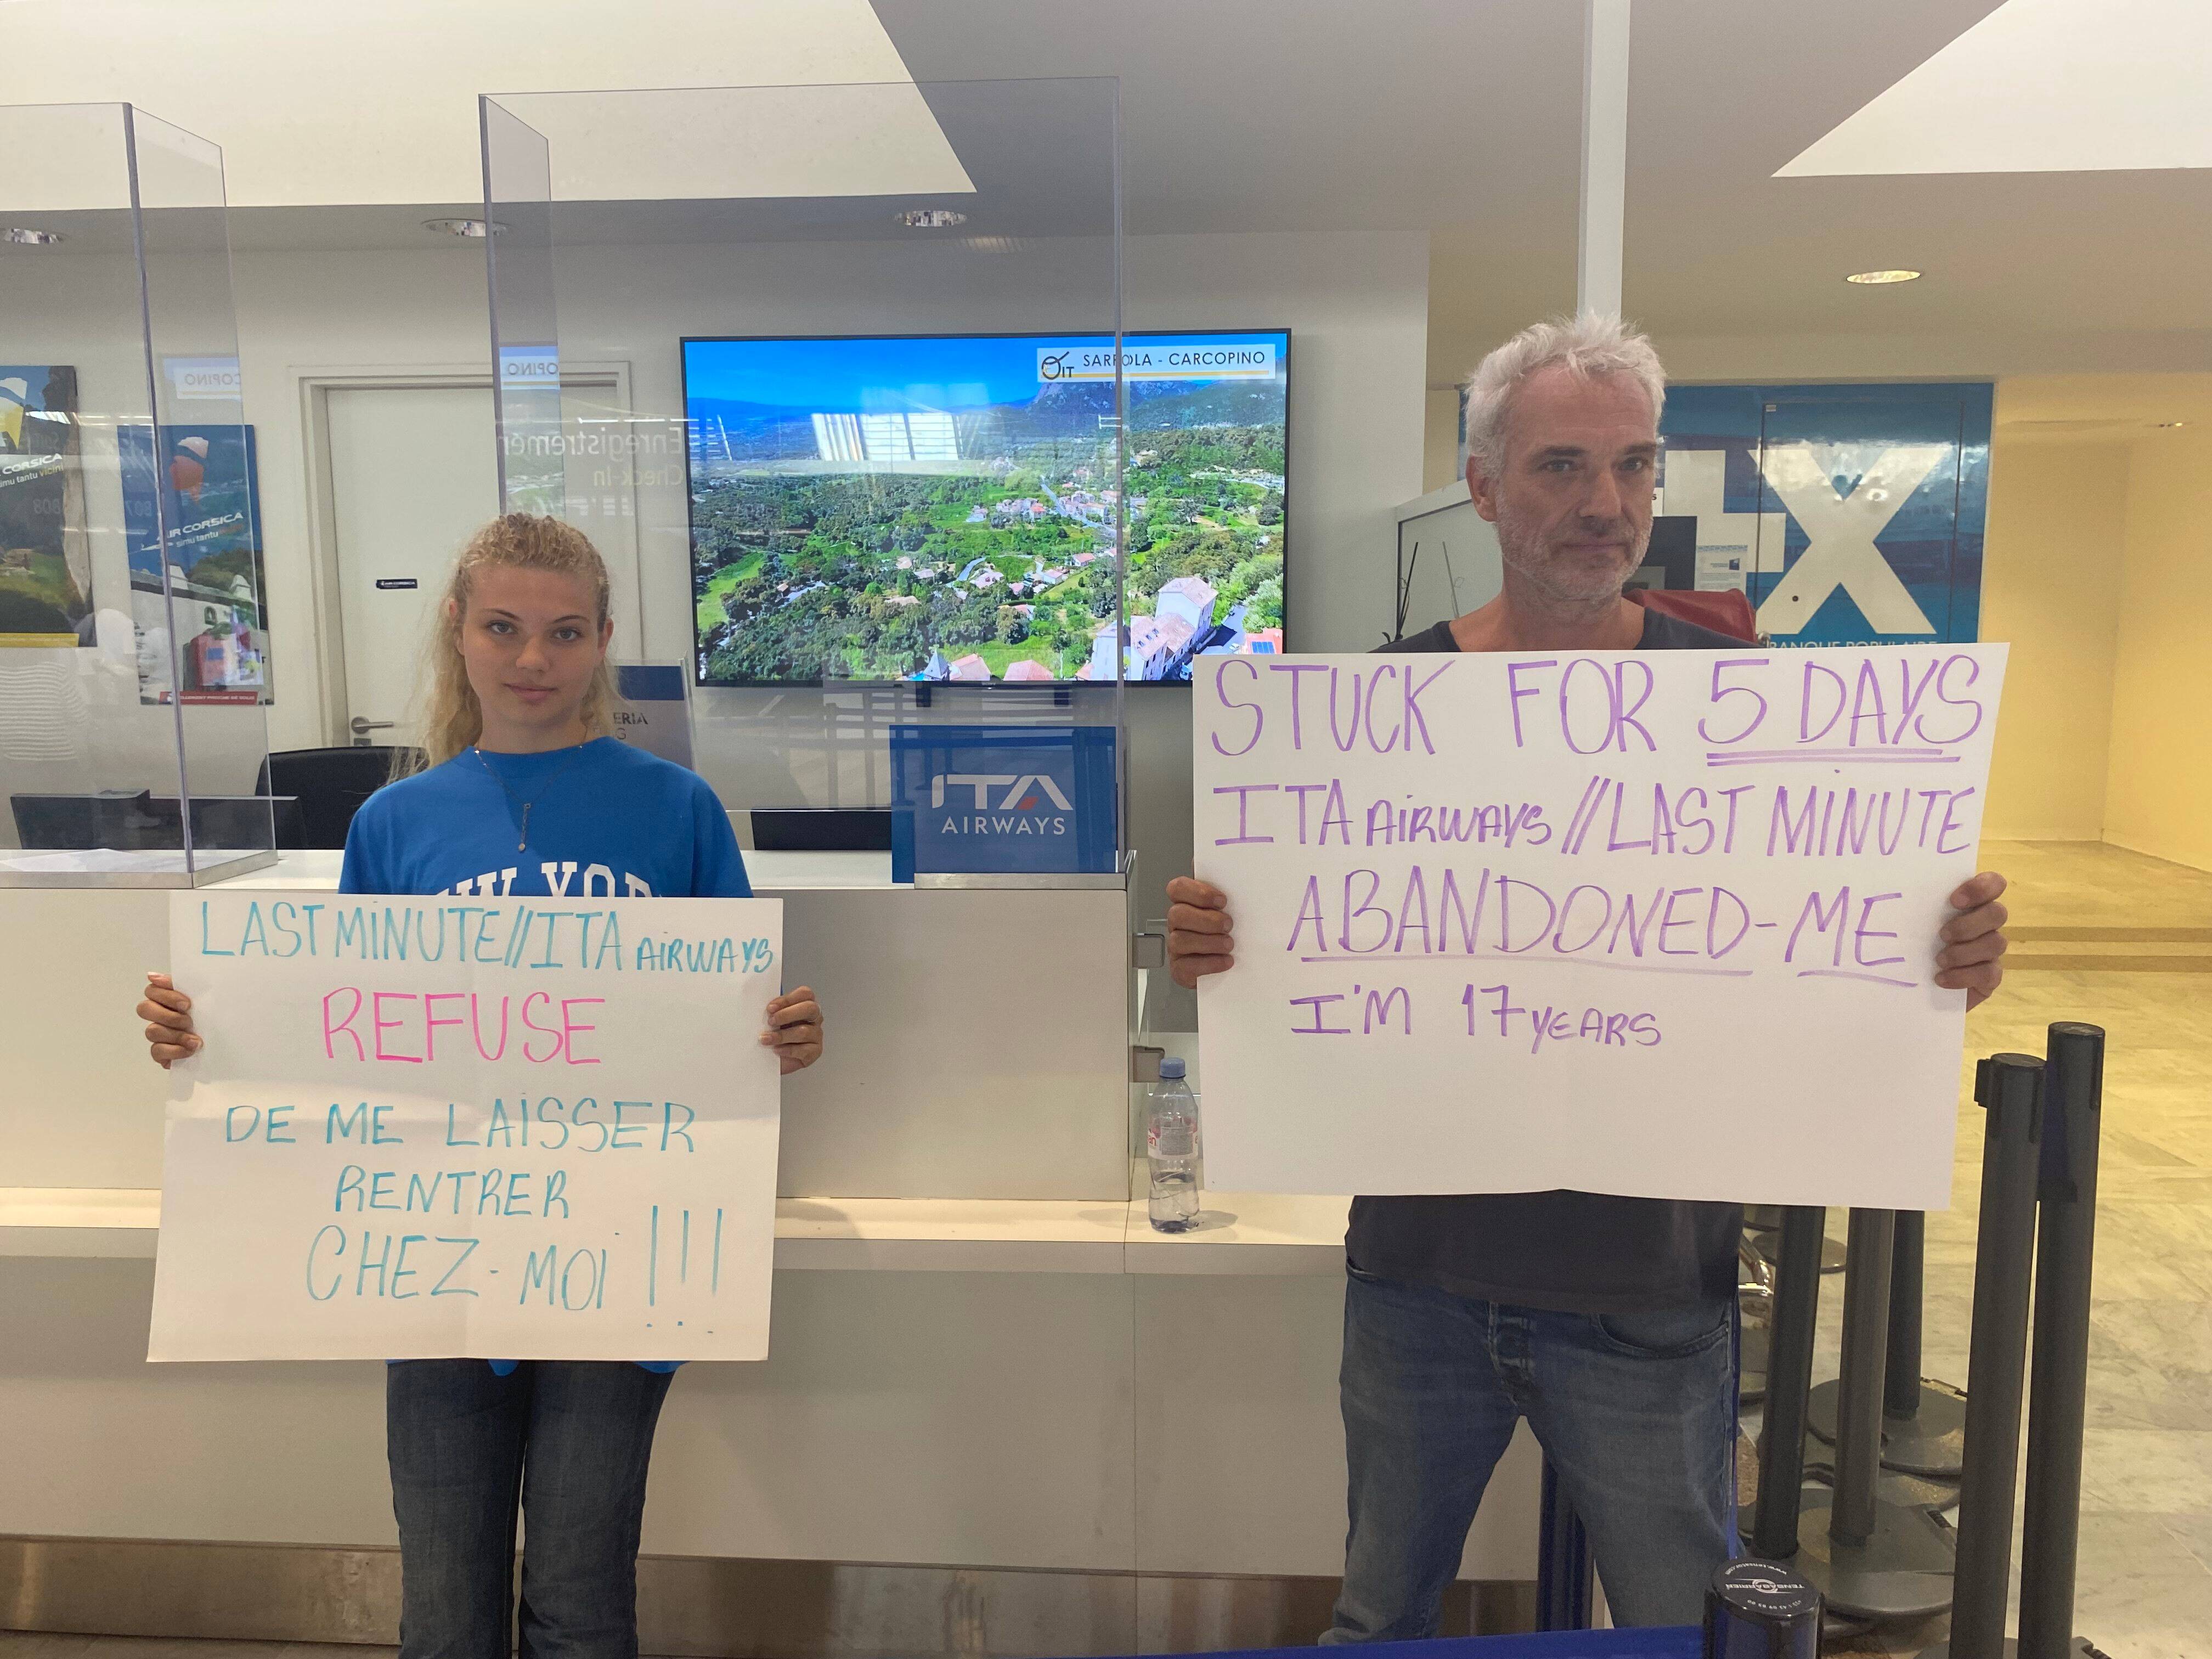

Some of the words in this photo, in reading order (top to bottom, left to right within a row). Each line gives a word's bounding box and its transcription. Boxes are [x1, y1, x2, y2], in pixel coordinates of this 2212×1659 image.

[1169, 351, 1265, 366] CARCOPINO
[2, 453, 63, 475] CORSICA
[16, 472, 38, 483] tantu
[182, 511, 244, 534] CORSICA
[1211, 660, 1457, 755] STUCK
[1508, 659, 1657, 754] FOR
[1697, 659, 1769, 744] 5
[1800, 654, 1983, 746] DAYS
[932, 774, 1074, 810] ITA
[941, 816, 1066, 835] AIRWAYS
[322, 987, 606, 1065] REFUSE
[1290, 984, 1412, 1035] I'M
[226, 1104, 297, 1143] DE
[325, 1102, 404, 1145] ME
[335, 1164, 569, 1219] RENTRER
